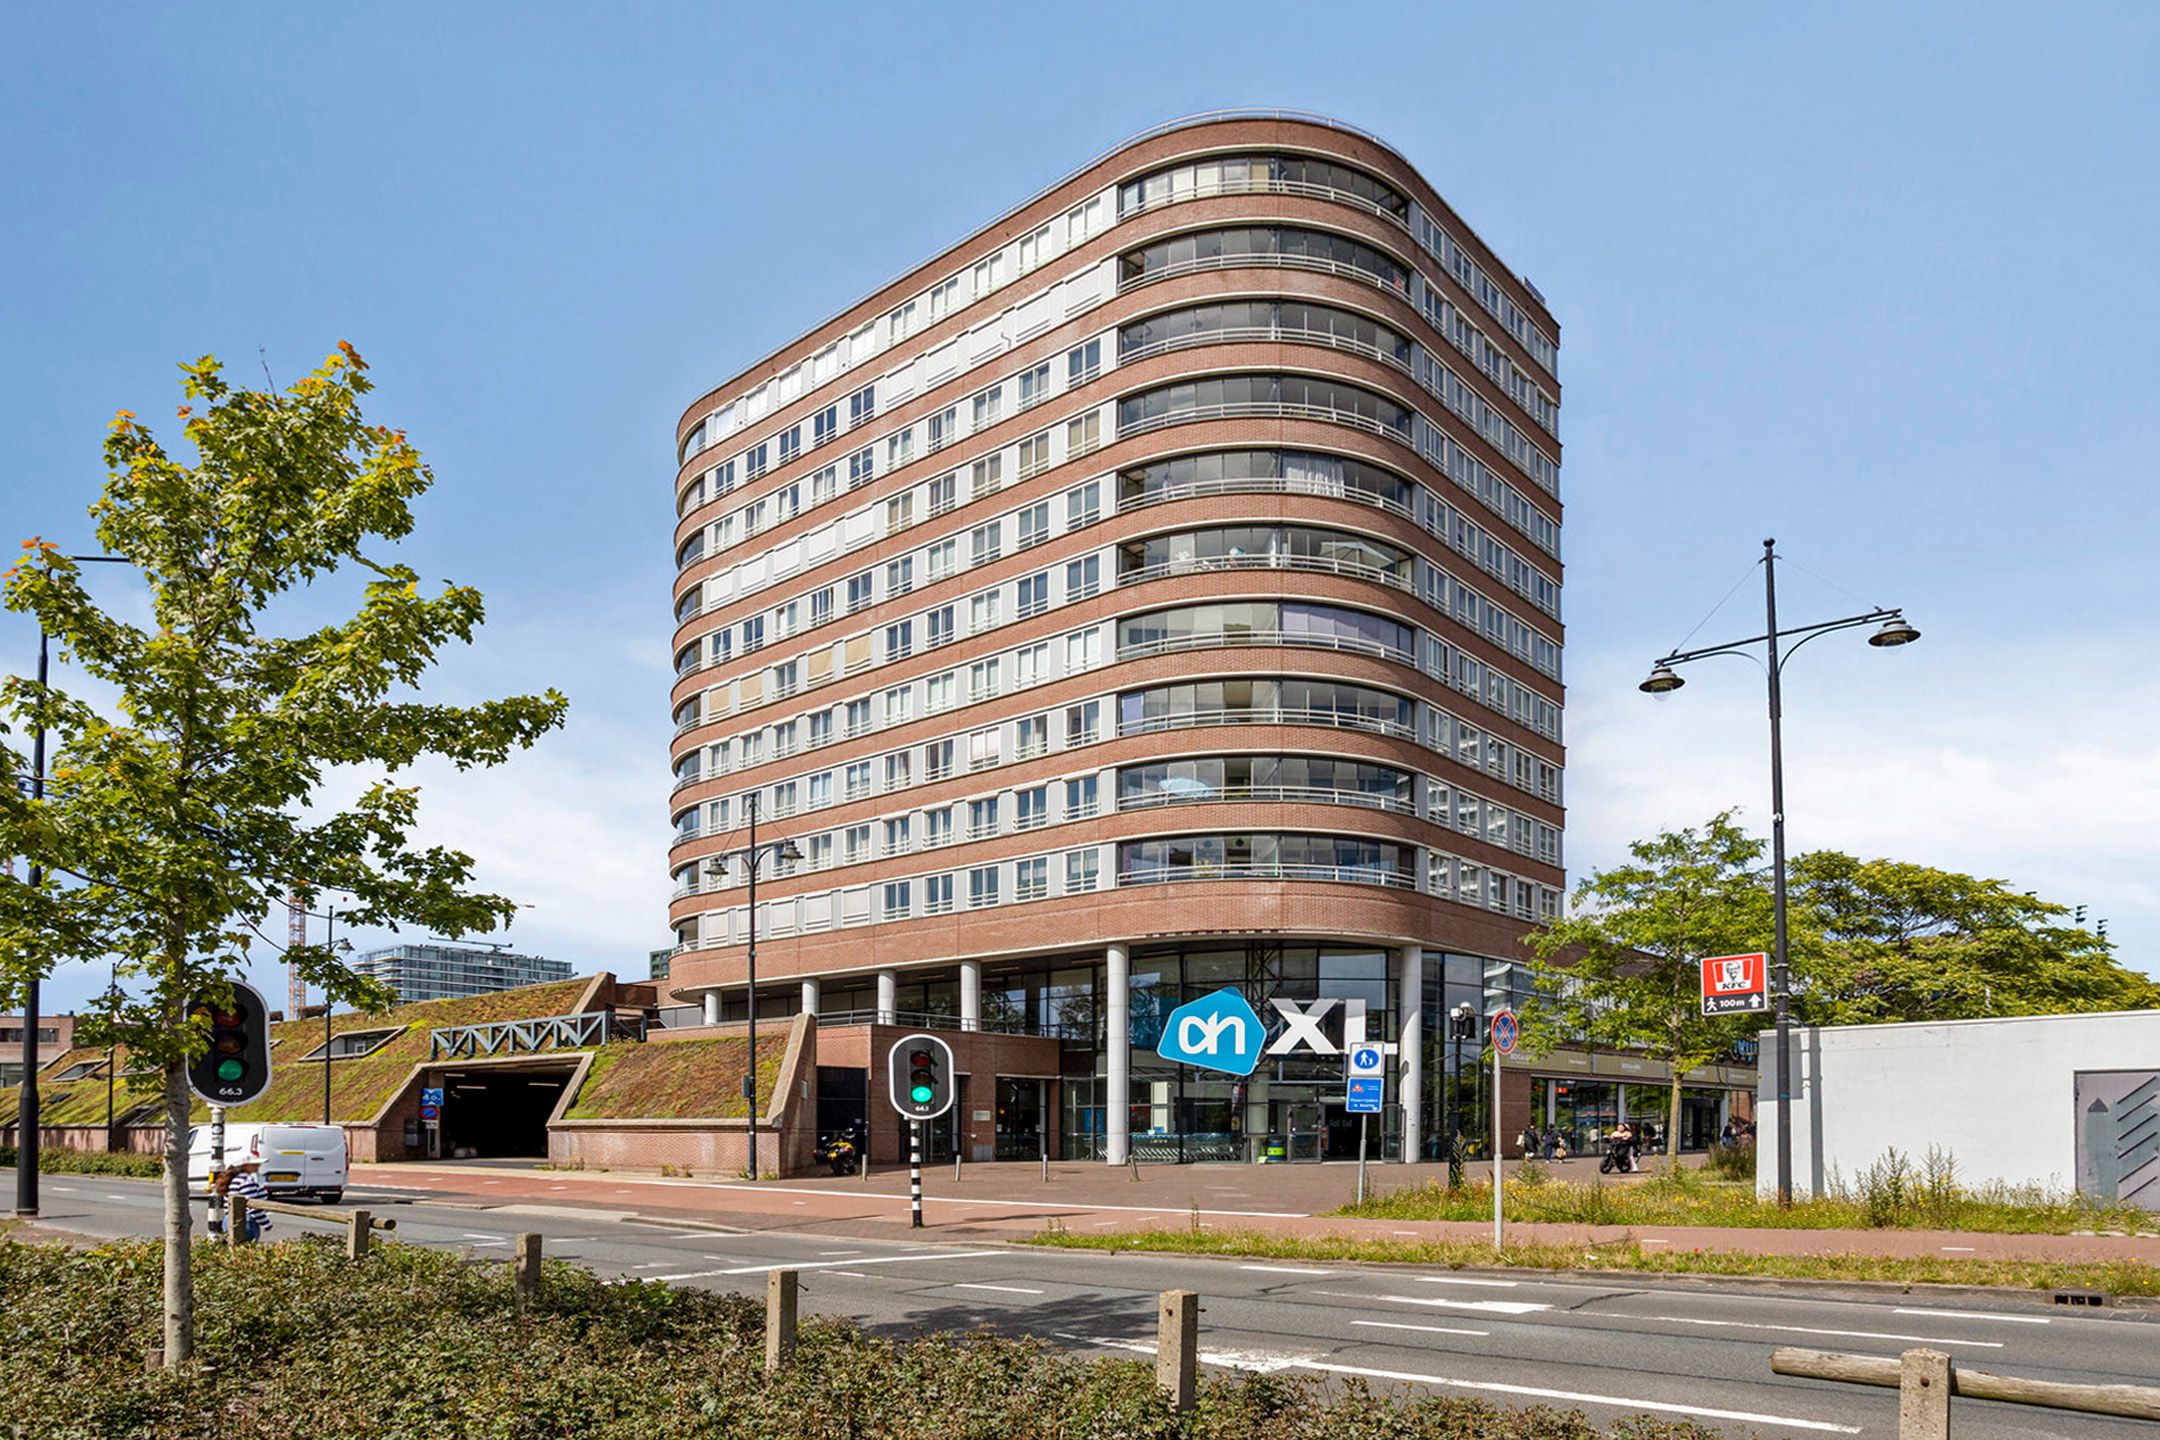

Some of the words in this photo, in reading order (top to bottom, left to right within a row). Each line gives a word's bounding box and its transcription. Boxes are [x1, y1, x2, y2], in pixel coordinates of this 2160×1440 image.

[1722, 981, 1746, 989] KFC
[1720, 999, 1735, 1008] 100
[219, 1087, 243, 1096] 66.3
